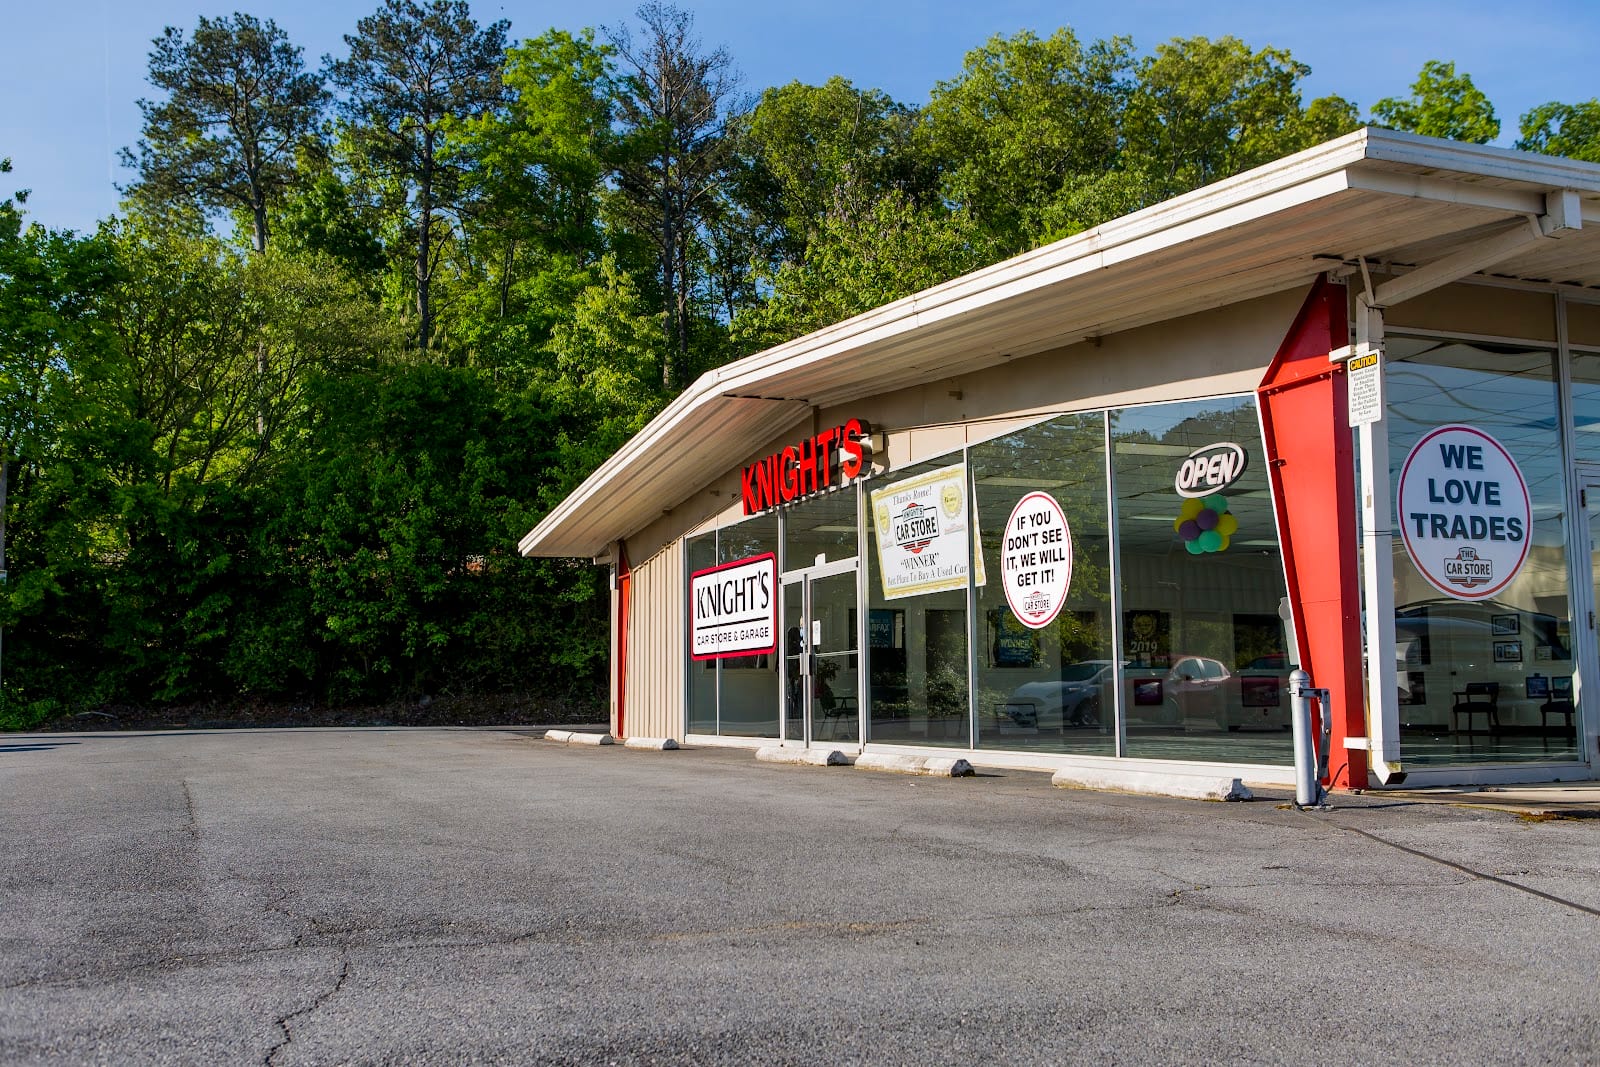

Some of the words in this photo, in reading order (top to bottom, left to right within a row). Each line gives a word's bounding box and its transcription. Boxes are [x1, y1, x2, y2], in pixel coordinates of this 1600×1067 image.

[1350, 354, 1377, 371] CAUTION
[741, 418, 863, 516] KNIGHT'S
[1439, 443, 1484, 470] WE
[1180, 451, 1236, 489] OPEN
[1428, 478, 1501, 506] LOVE
[896, 525, 910, 541] CAR
[911, 517, 937, 538] STORE
[1017, 516, 1026, 530] IF
[1029, 510, 1051, 528] YOU
[1410, 512, 1523, 542] TRADES
[1008, 532, 1038, 551] DON'T
[1042, 528, 1062, 545] SEE
[1006, 556, 1018, 571] IT,
[1020, 552, 1036, 568] WE
[1039, 548, 1065, 565] WILL
[1460, 550, 1474, 559] THE
[937, 565, 952, 578] Used
[954, 563, 968, 574] Car
[1018, 572, 1038, 587] GET
[1042, 568, 1054, 584] IT!
[1446, 562, 1463, 575] CAR
[1464, 563, 1490, 575] STORE
[697, 570, 770, 620] KNIGHT'S
[1034, 599, 1049, 610] STORE
[697, 636, 710, 646] CAR
[710, 632, 732, 645] STORE
[734, 630, 738, 642] &
[740, 626, 769, 640] GARAGE
[1130, 641, 1158, 655] 2019
